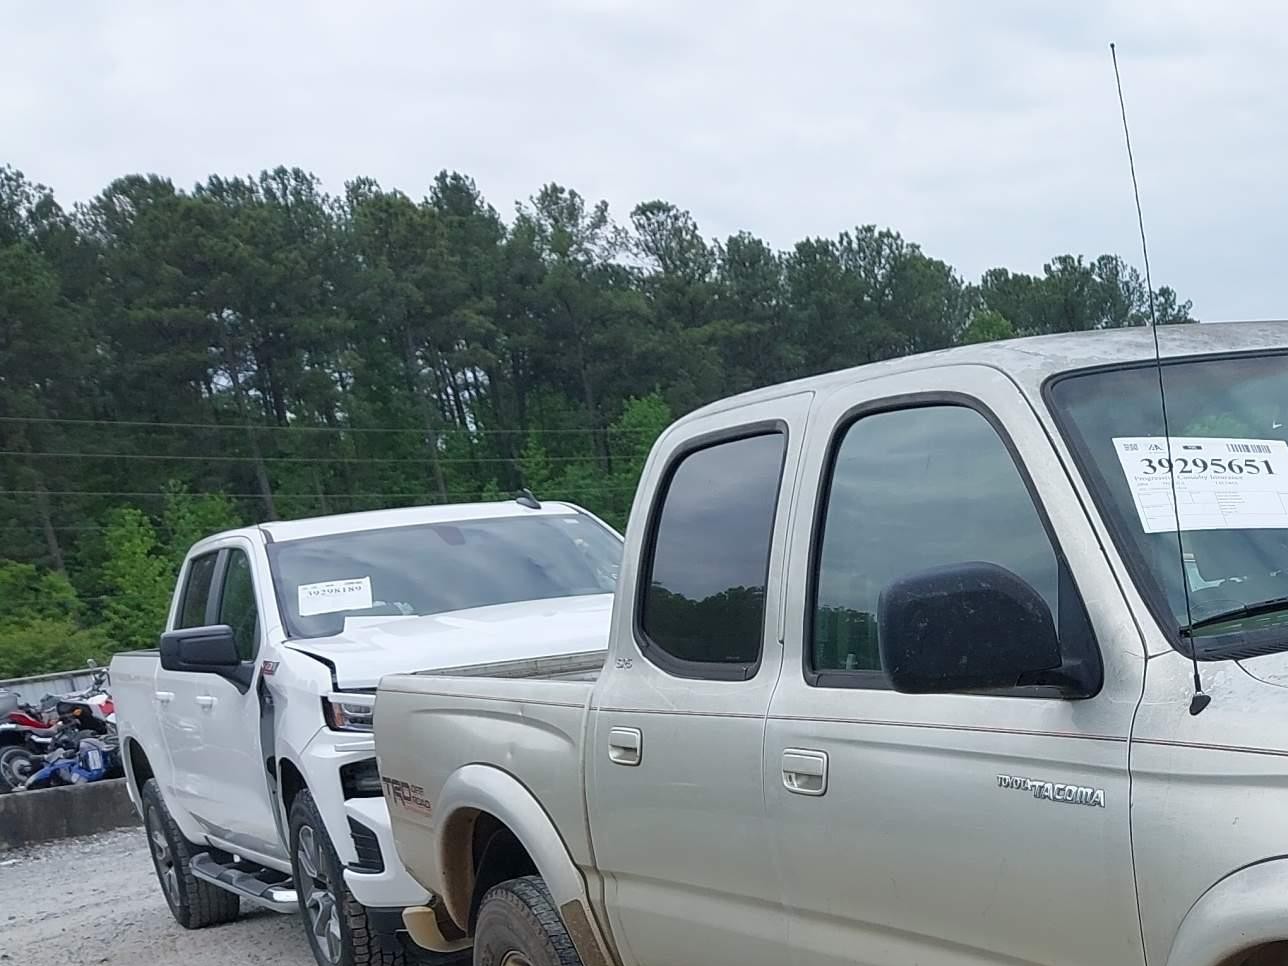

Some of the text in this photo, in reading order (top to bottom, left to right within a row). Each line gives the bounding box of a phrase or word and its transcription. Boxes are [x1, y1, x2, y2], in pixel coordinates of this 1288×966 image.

[1140, 457, 1275, 475] 39295651
[382, 776, 412, 806] TRD
[996, 774, 1105, 808] TOYOTA TACOMA
